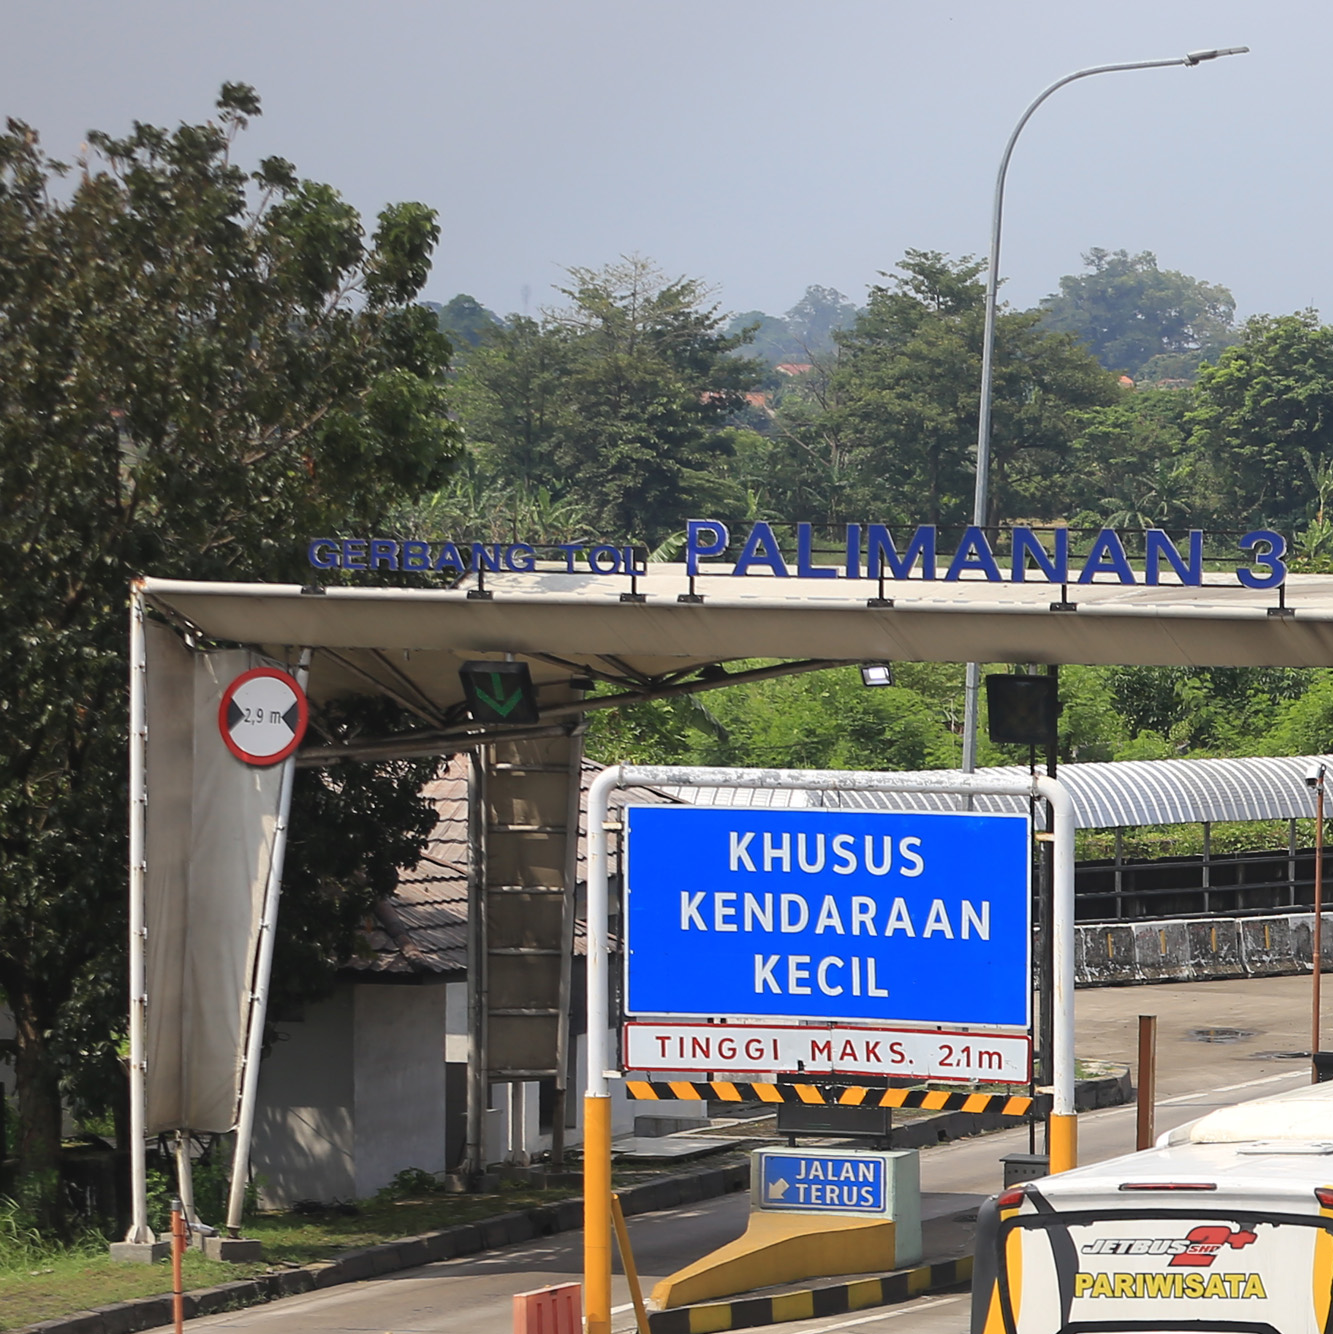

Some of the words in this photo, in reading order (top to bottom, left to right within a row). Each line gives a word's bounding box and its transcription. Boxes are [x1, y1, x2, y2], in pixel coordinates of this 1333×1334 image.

[308, 538, 538, 573] GERBANG
[559, 543, 647, 576] TOL
[685, 518, 1204, 588] PALIMANAN
[1236, 529, 1289, 590] 3
[244, 707, 264, 726] 2,9
[269, 711, 281, 724] m
[729, 830, 925, 878] KHUSUS
[680, 890, 990, 941] KENDARAAN
[754, 954, 889, 998] KECIL
[655, 1035, 780, 1062] TINGGI
[810, 1039, 914, 1065] MAKS.
[795, 1160, 875, 1182] JALAN
[795, 1183, 874, 1206] TERUS
[1081, 1238, 1191, 1255] JETBUS
[1073, 1271, 1268, 1299] PARIWISATA
